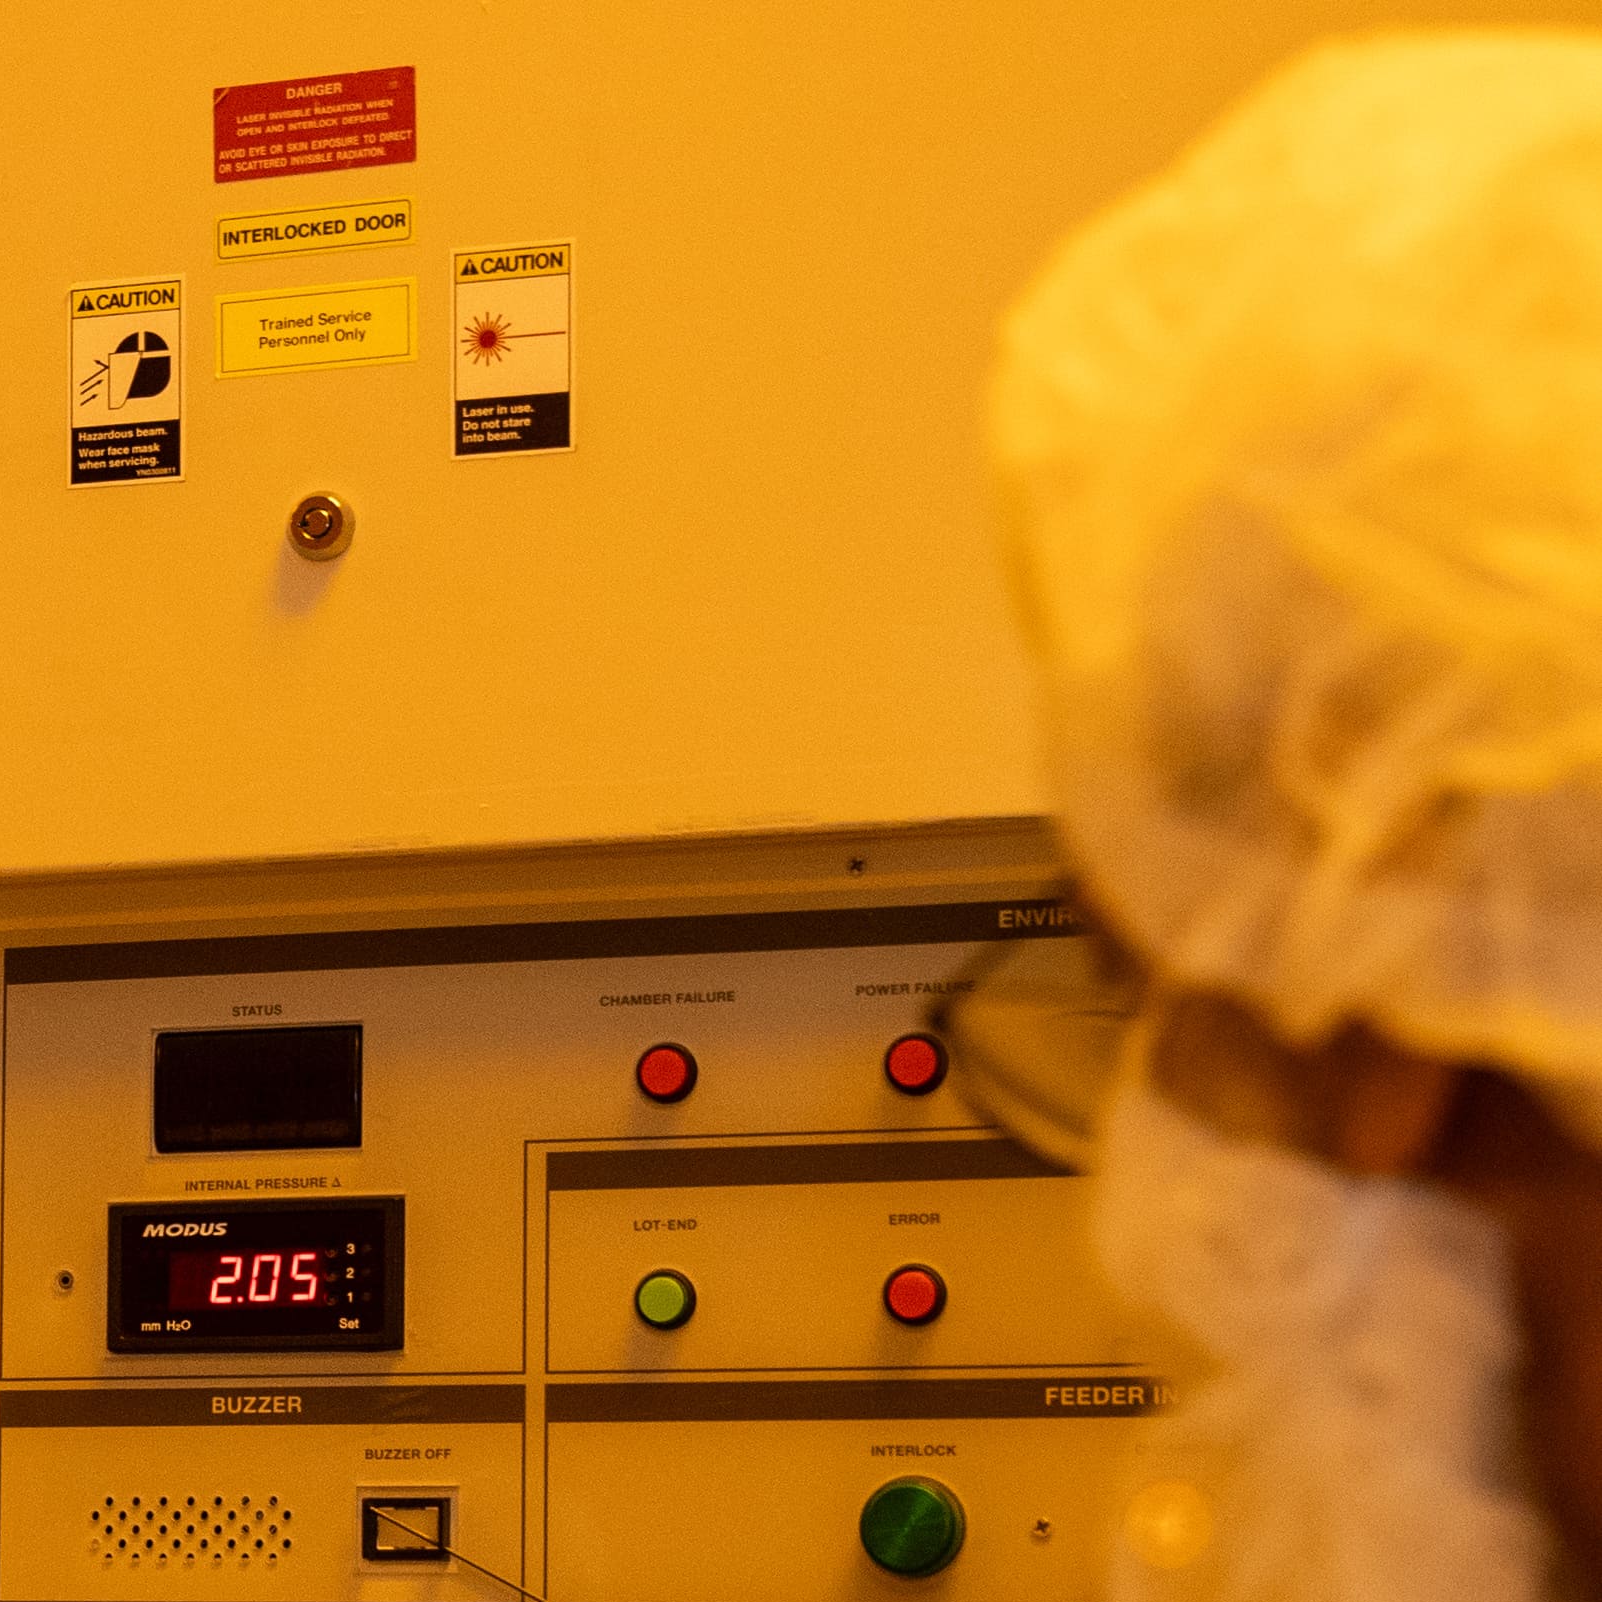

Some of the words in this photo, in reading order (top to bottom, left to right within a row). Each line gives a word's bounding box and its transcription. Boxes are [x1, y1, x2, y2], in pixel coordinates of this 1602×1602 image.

[286, 83, 342, 99] DANGER
[237, 114, 266, 124] LASER
[269, 108, 311, 120] INVISIBLE
[314, 102, 362, 115] RADIATION
[366, 99, 393, 108] WHEN
[237, 126, 262, 136] OPEN
[265, 124, 284, 133] AND
[288, 118, 338, 131] INTERLOCK
[219, 148, 245, 159] AVOID
[249, 146, 266, 156] EYE
[270, 145, 283, 154] OR
[287, 142, 308, 152] SKIN
[312, 136, 359, 149] EXPOSURE
[364, 134, 375, 143] TO
[380, 130, 412, 142] DIRECT
[219, 164, 231, 174] OR
[236, 158, 286, 171] SCATTERED
[291, 153, 333, 166] INVISIBLE
[224, 220, 346, 246] INTERLOCKED
[356, 213, 406, 232] DOOR
[481, 252, 563, 274] CAUTION
[96, 288, 174, 310] CAUTION
[260, 315, 313, 331] Trained
[318, 311, 372, 325] Service
[259, 331, 329, 348] Personnel
[335, 329, 366, 342] Only
[463, 406, 493, 417] Laser
[497, 405, 507, 414] in
[511, 404, 535, 413] use.
[463, 421, 478, 431] Do
[481, 419, 500, 429] not
[503, 418, 531, 427] stare
[79, 428, 133, 441] Hazardous
[136, 427, 168, 436] beam.
[463, 433, 484, 443] into
[487, 431, 521, 441] beam.
[79, 447, 105, 458] Wear
[108, 445, 129, 455] face
[132, 443, 160, 453] mask
[79, 459, 106, 469] when
[109, 456, 159, 468] servicing.
[998, 907, 1073, 928] ENVIR
[856, 984, 909, 997] POWER
[600, 994, 671, 1008] CHAMBER
[677, 990, 735, 1006] FAILURE
[232, 1004, 282, 1017] STATUS
[186, 1180, 250, 1191] INTERNAL
[256, 1178, 326, 1190] PRESSURE
[634, 1219, 697, 1232] LOT-END
[889, 1213, 940, 1226] ERROR
[142, 1223, 228, 1237] MODUS
[346, 1244, 355, 1254] 3
[210, 1253, 317, 1304] 2.05
[346, 1268, 354, 1278] 2
[347, 1293, 354, 1302] 1
[141, 1323, 161, 1331] mm
[339, 1318, 359, 1329] Set
[1046, 1386, 1144, 1406] FEEDER
[212, 1397, 302, 1414] BUZZER
[365, 1449, 420, 1459] BUZZER
[425, 1449, 451, 1459] OFF
[871, 1445, 956, 1457] INTERLOCK
